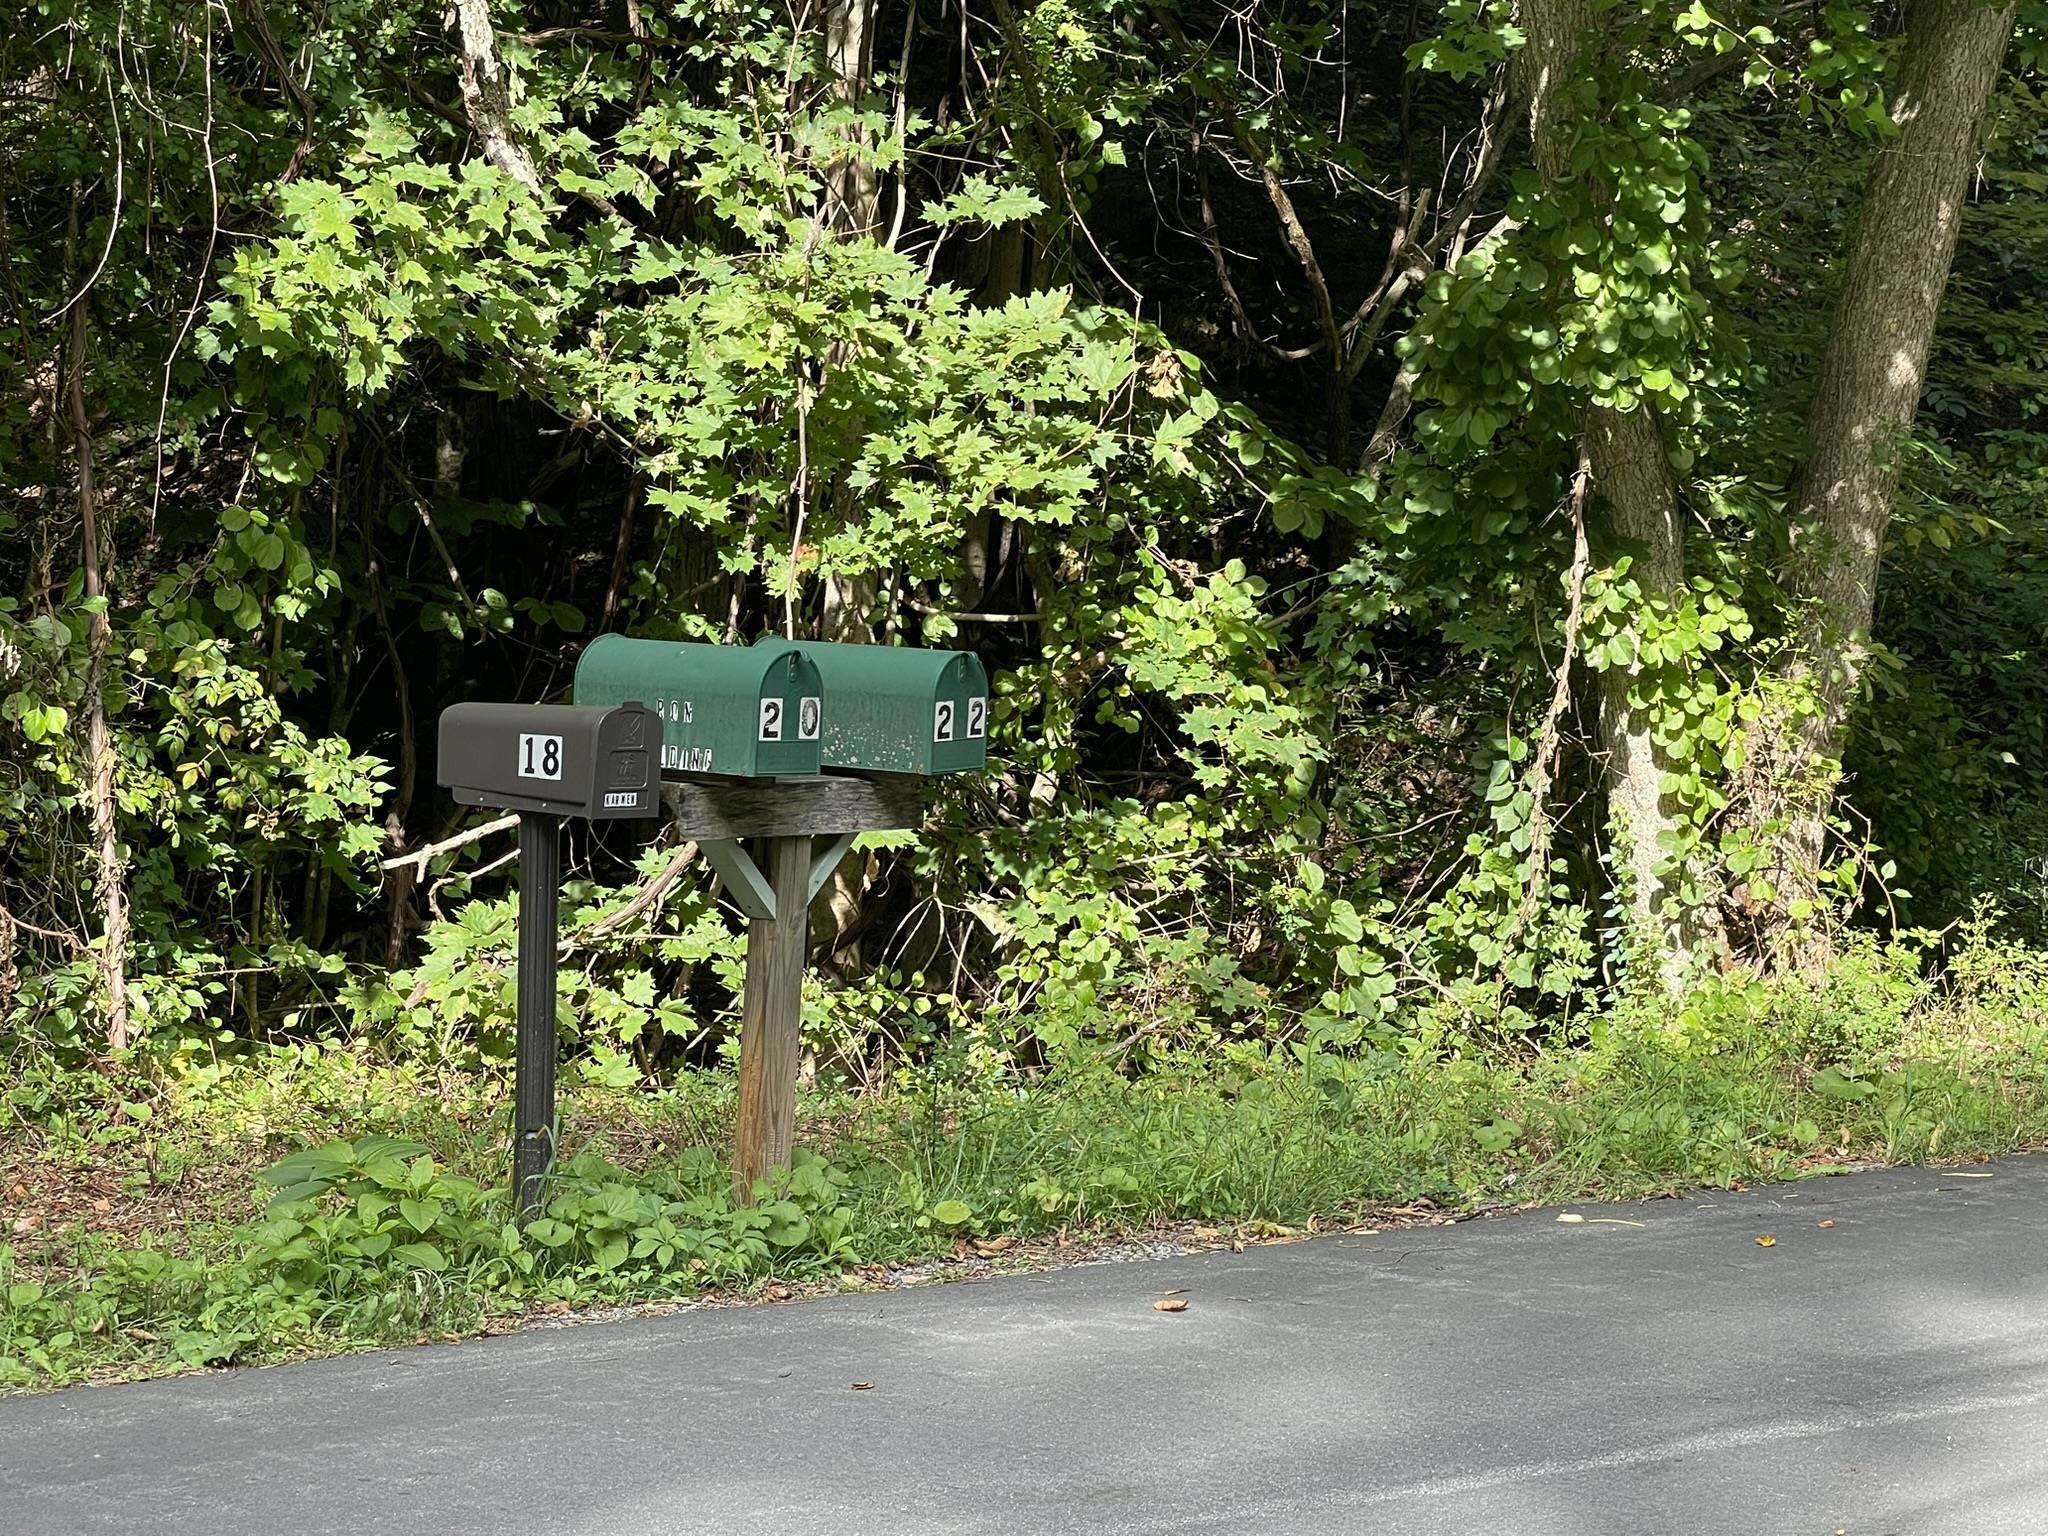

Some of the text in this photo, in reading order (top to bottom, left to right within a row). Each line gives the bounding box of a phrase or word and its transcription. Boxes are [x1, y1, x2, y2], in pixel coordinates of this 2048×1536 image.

[762, 699, 819, 738] 20
[937, 699, 985, 740] 22
[524, 737, 560, 776] 18
